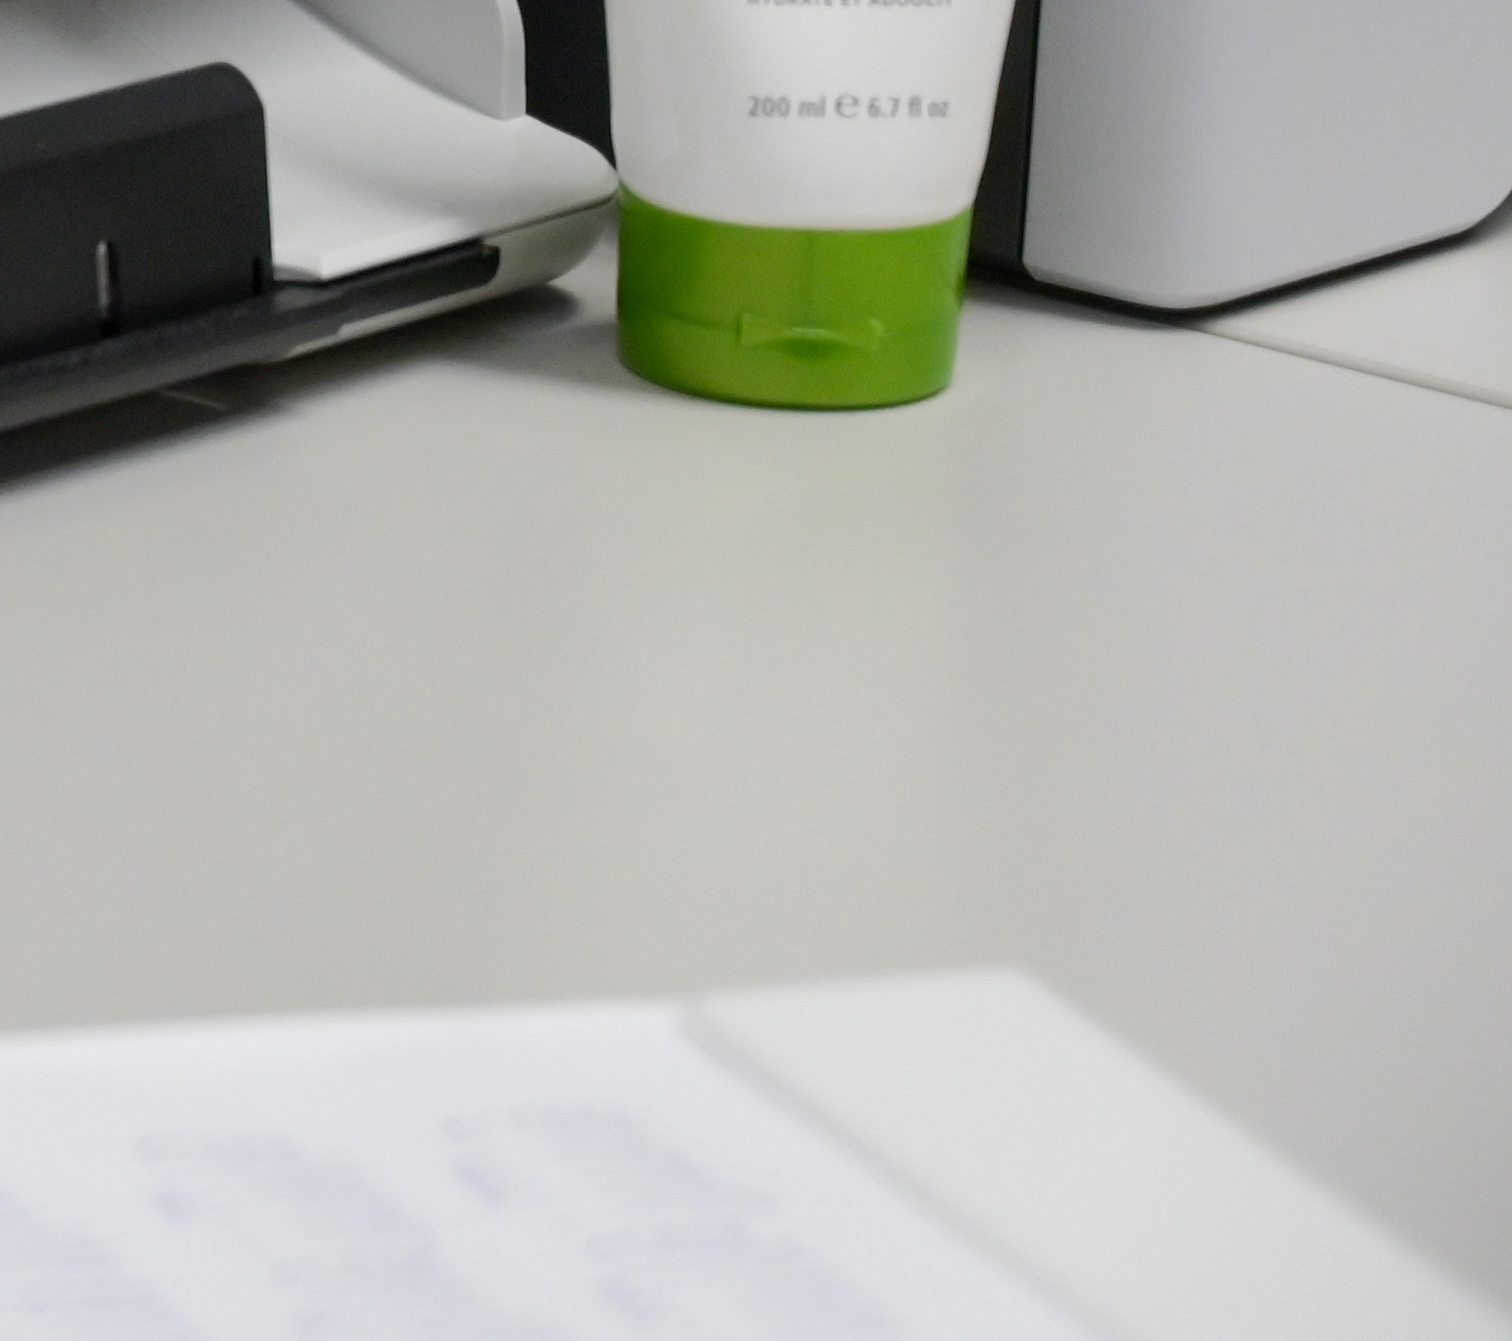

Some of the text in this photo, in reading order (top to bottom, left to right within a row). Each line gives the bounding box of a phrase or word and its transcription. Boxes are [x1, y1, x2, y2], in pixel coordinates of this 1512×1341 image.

[748, 95, 790, 118] 200
[798, 96, 825, 118] ml
[867, 97, 900, 119] 6.7
[908, 97, 922, 118] fl
[928, 101, 949, 118] oz
